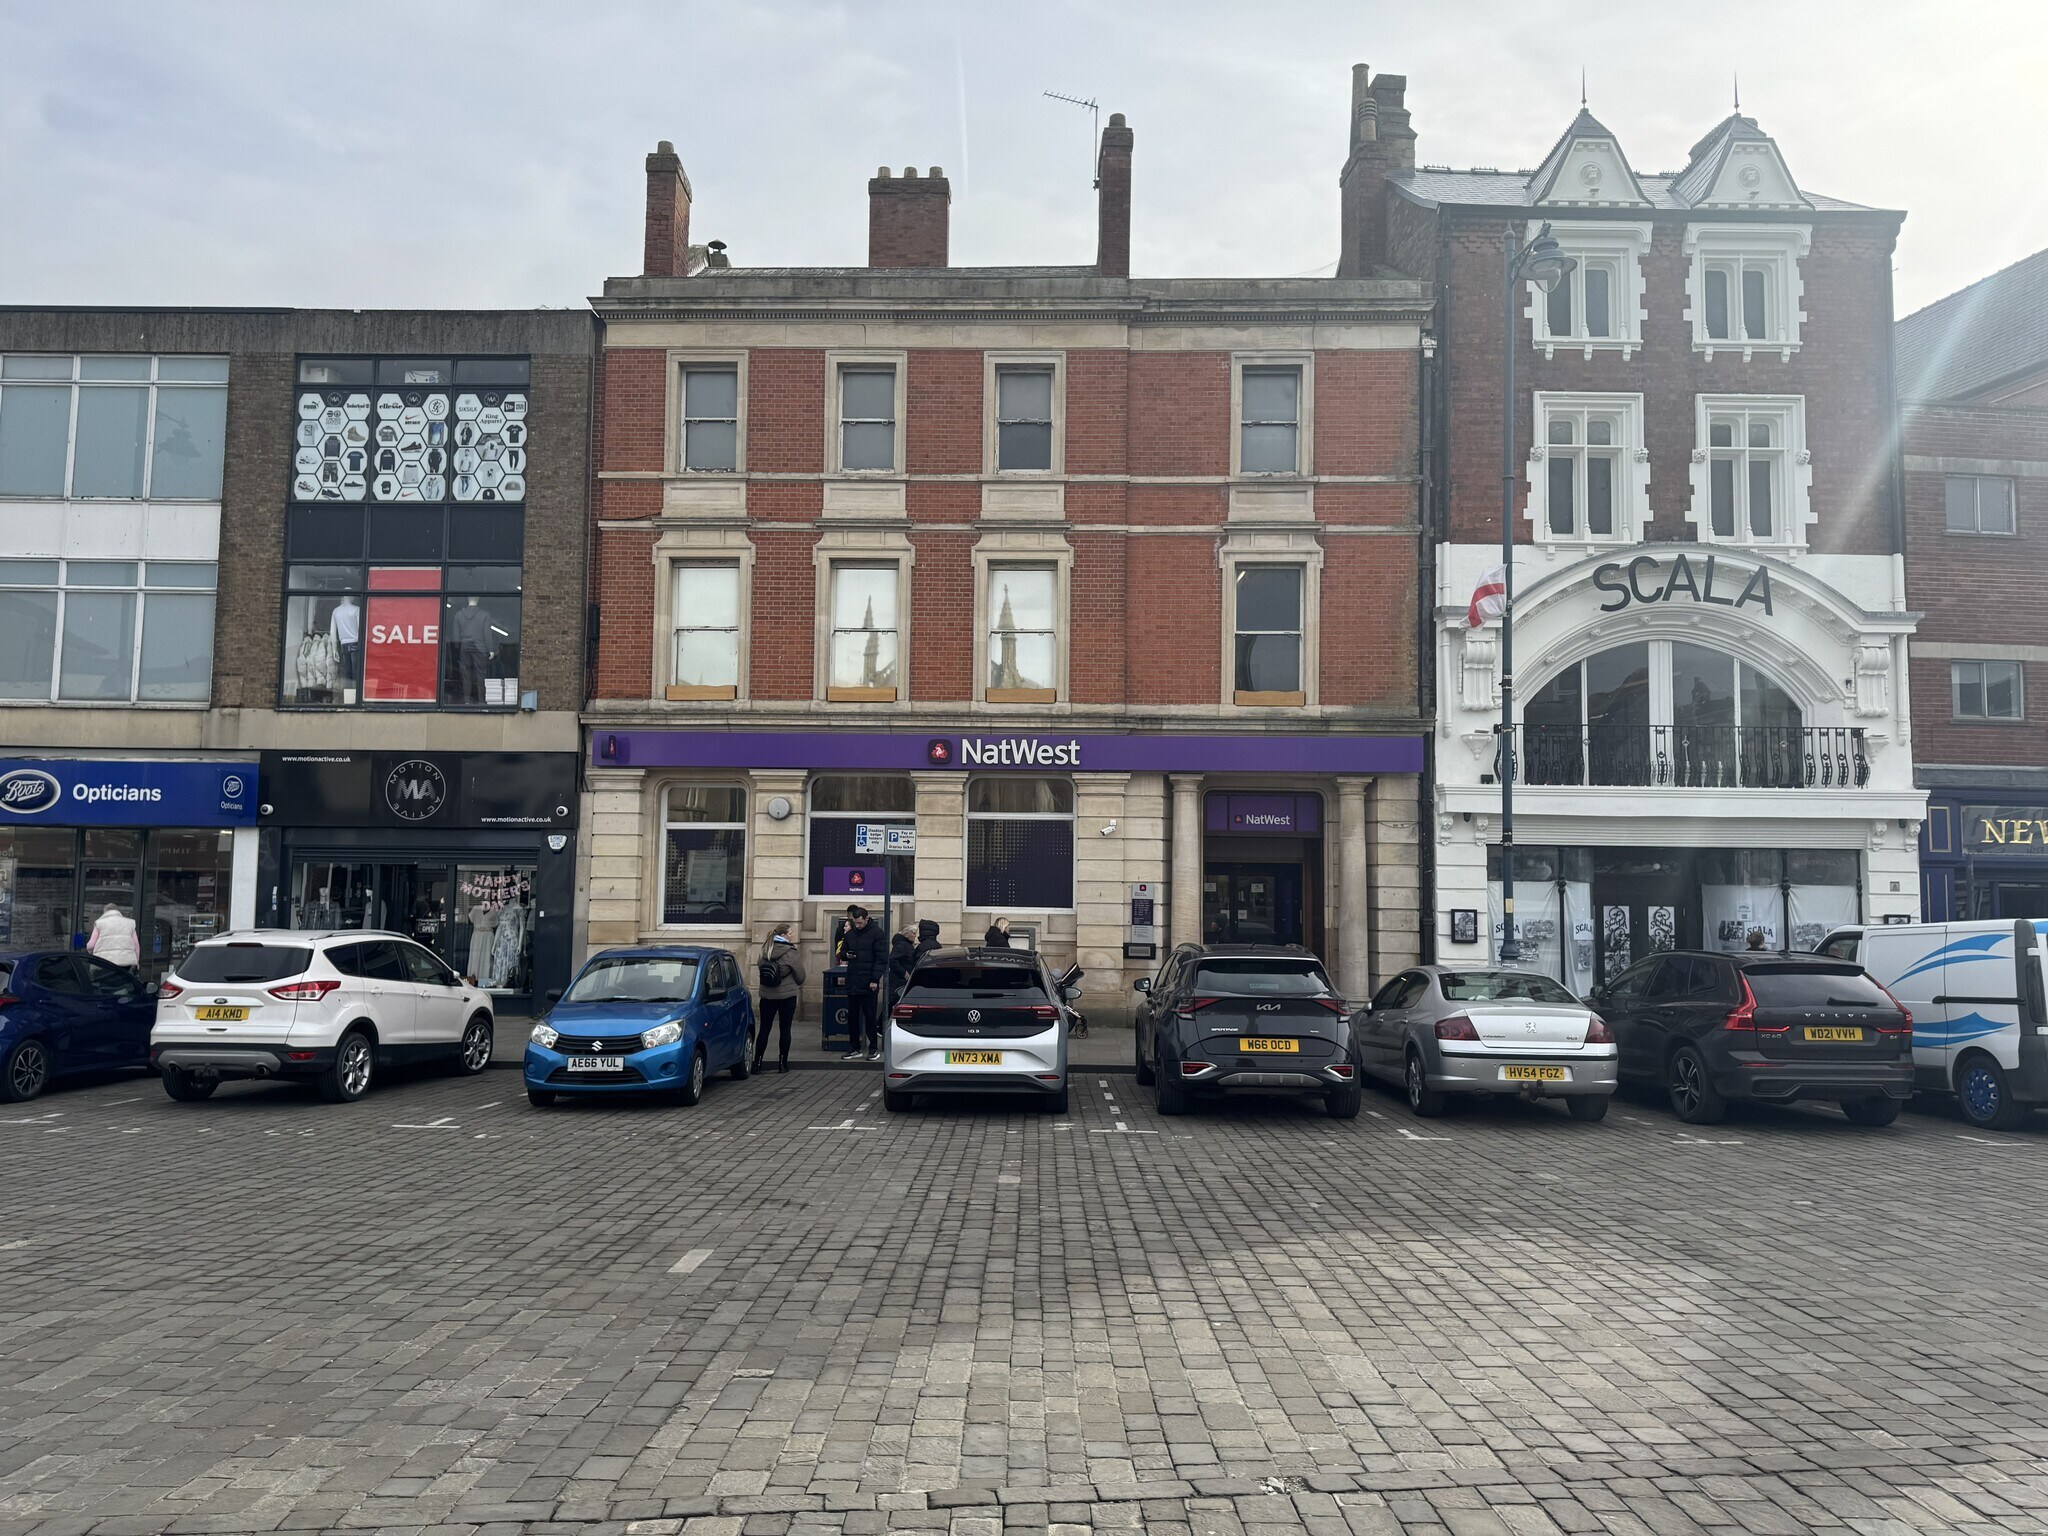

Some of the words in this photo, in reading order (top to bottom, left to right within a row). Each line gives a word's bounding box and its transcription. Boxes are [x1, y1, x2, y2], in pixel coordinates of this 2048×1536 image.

[1592, 553, 1774, 617] SCALA
[371, 624, 439, 644] SALE
[961, 738, 1081, 765] NatWest
[281, 755, 351, 763] www.motionactive.co.uk
[390, 763, 441, 784] MOTION
[2, 780, 45, 802] Boots
[72, 783, 162, 803] Opticians
[220, 801, 243, 810] Opticians
[393, 795, 441, 817] ACTIVE
[1246, 814, 1290, 825] NatWest
[473, 873, 521, 888] HAPPY
[206, 1008, 221, 1018] A14
[222, 1008, 243, 1019] KMD
[1810, 1028, 1834, 1038] WD21
[1836, 1028, 1856, 1039] VVH
[1270, 1040, 1291, 1050] OCD
[571, 1057, 598, 1068] AE66
[600, 1057, 620, 1068] YUL
[951, 1052, 978, 1063] VN73
[980, 1052, 1000, 1063] XMA
[1509, 1067, 1537, 1078] HV54
[1540, 1068, 1560, 1079] FGZ
